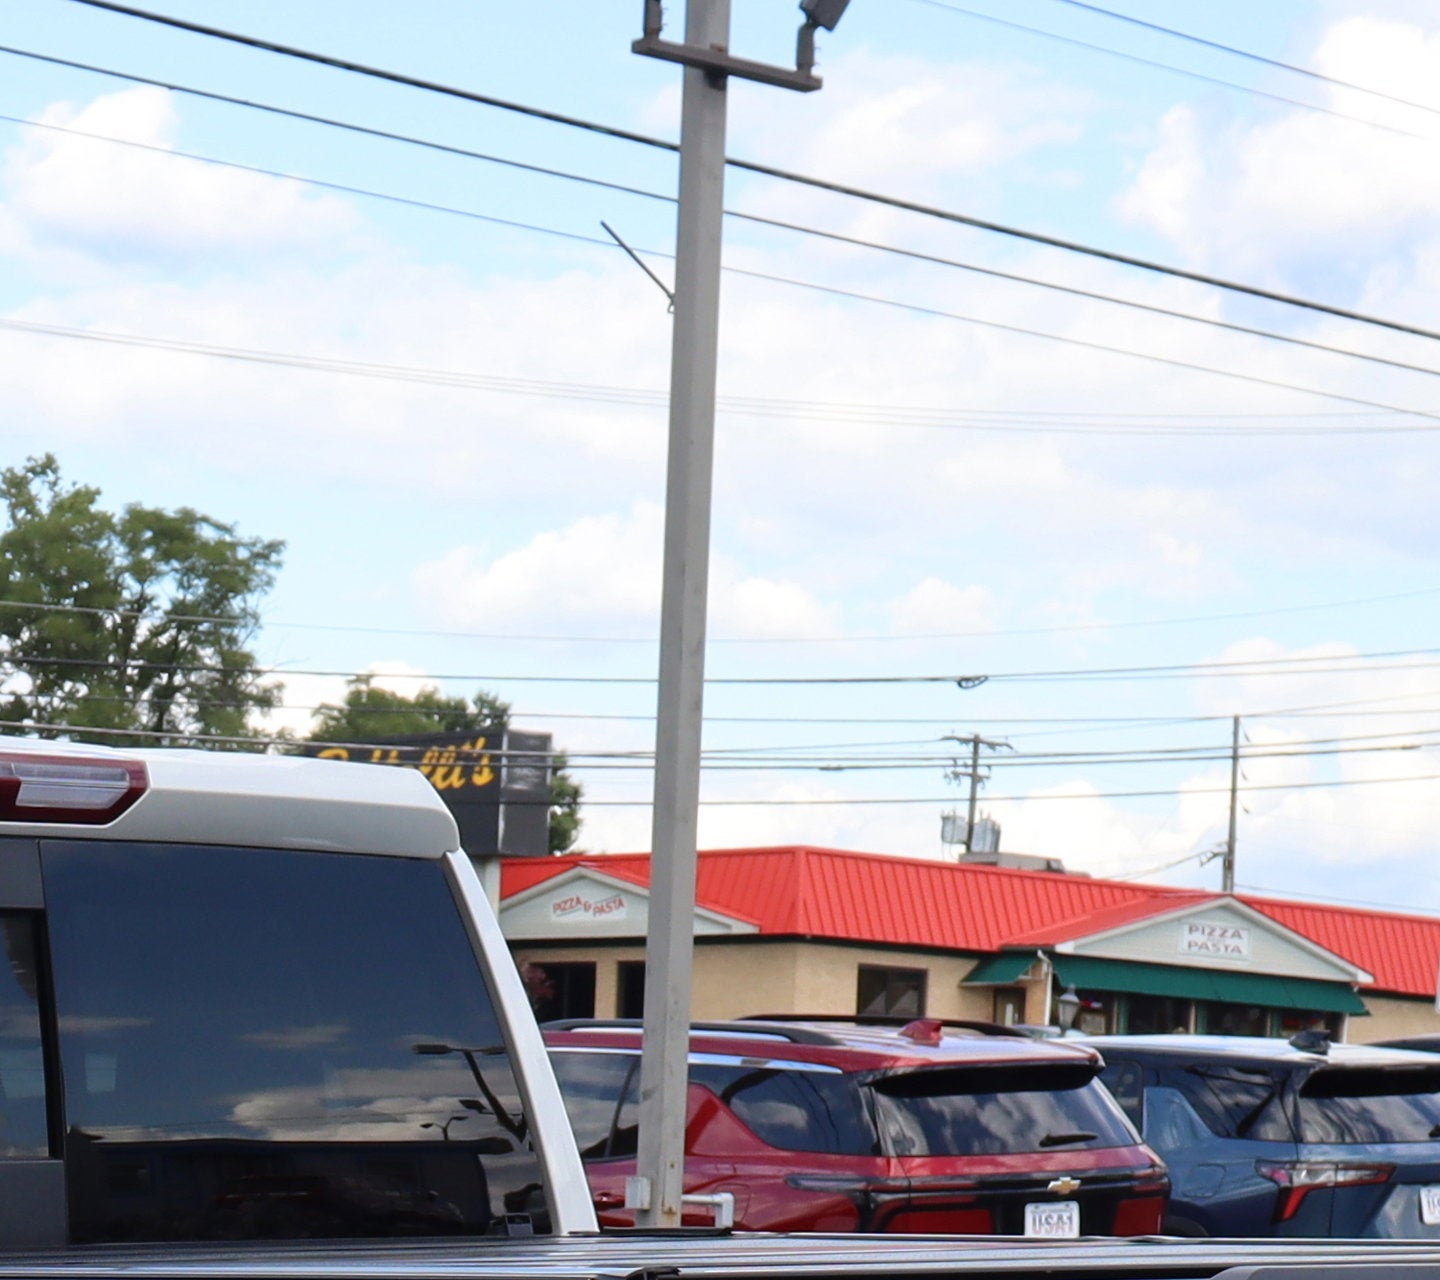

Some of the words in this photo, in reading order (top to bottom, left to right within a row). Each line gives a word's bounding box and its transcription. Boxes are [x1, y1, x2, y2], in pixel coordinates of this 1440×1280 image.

[552, 896, 583, 915] PIZZA
[592, 897, 625, 917] PASTA
[1188, 924, 1243, 940] PIZZA
[1187, 940, 1242, 954] PASTA
